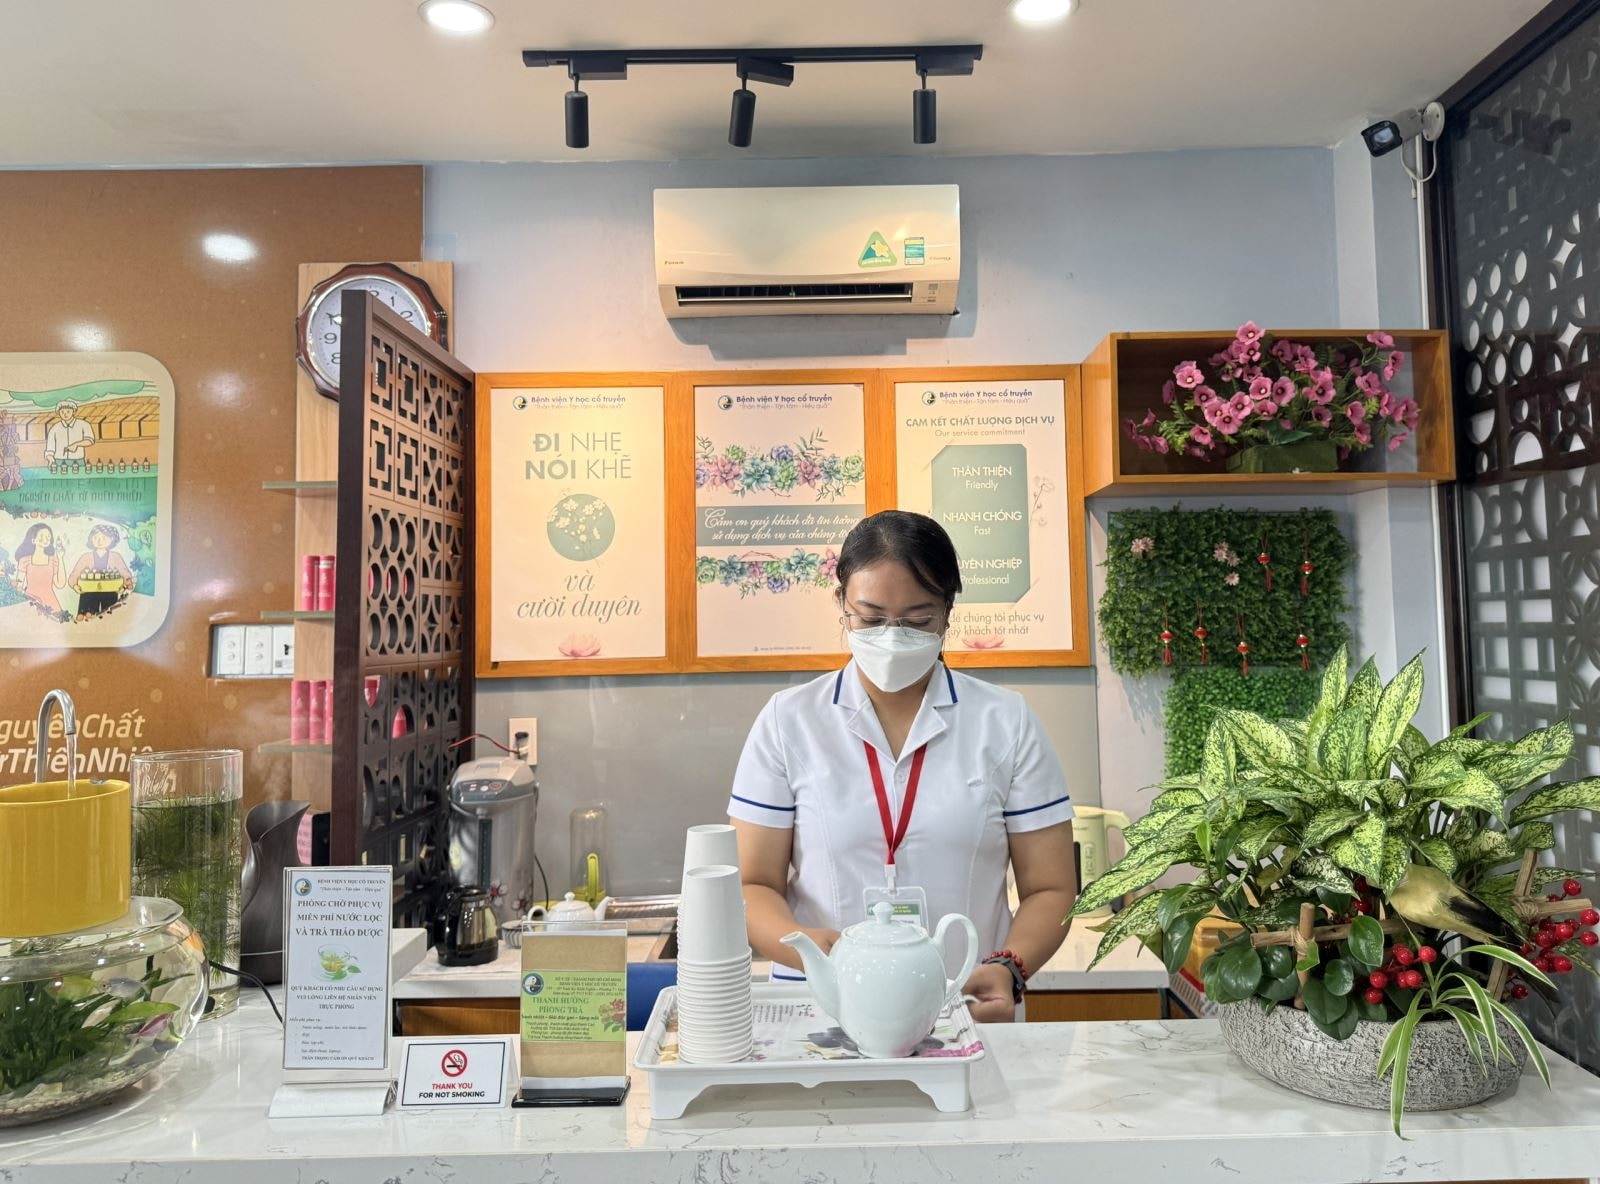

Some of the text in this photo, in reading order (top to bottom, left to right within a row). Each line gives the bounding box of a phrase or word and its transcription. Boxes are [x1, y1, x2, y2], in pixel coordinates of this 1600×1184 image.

[390, 295, 395, 307] 1
[324, 333, 338, 344] 9
[575, 396, 590, 404] học
[736, 395, 755, 404] Bệnh
[757, 395, 773, 405] viện
[781, 395, 796, 404] học
[959, 391, 975, 400] viện
[983, 391, 997, 399] học
[906, 418, 928, 427] CAM
[930, 415, 947, 426] KẾT
[950, 415, 975, 426] CHẤT
[1015, 416, 1038, 427] DỊCH
[1041, 416, 1055, 426] VỤ
[934, 429, 950, 437] Our
[952, 429, 978, 437] service
[533, 432, 622, 455] ĐI NHẸ
[525, 453, 632, 480] NÓI KHẼ
[965, 479, 999, 492] Friendly
[771, 513, 801, 527] khách
[943, 509, 1023, 523] NHANH CHÓNG
[974, 525, 992, 536] Fast
[958, 556, 1023, 571] UYÊN NGHIỆP
[564, 569, 596, 592] và
[961, 574, 1010, 586] Professional
[516, 593, 643, 624] cười duyên
[963, 611, 992, 624] chúng
[1008, 611, 1031, 624] phục
[1033, 613, 1045, 623] vụ
[964, 626, 992, 636] khách
[297, 899, 327, 908] PHÒNG
[347, 900, 370, 909] PHỤC
[371, 901, 383, 910] VỤ
[320, 913, 334, 921] PHÍ
[335, 912, 362, 922] NƯỚC
[363, 914, 383, 923] LỌC
[451, 1090, 485, 1098] SMOKING
